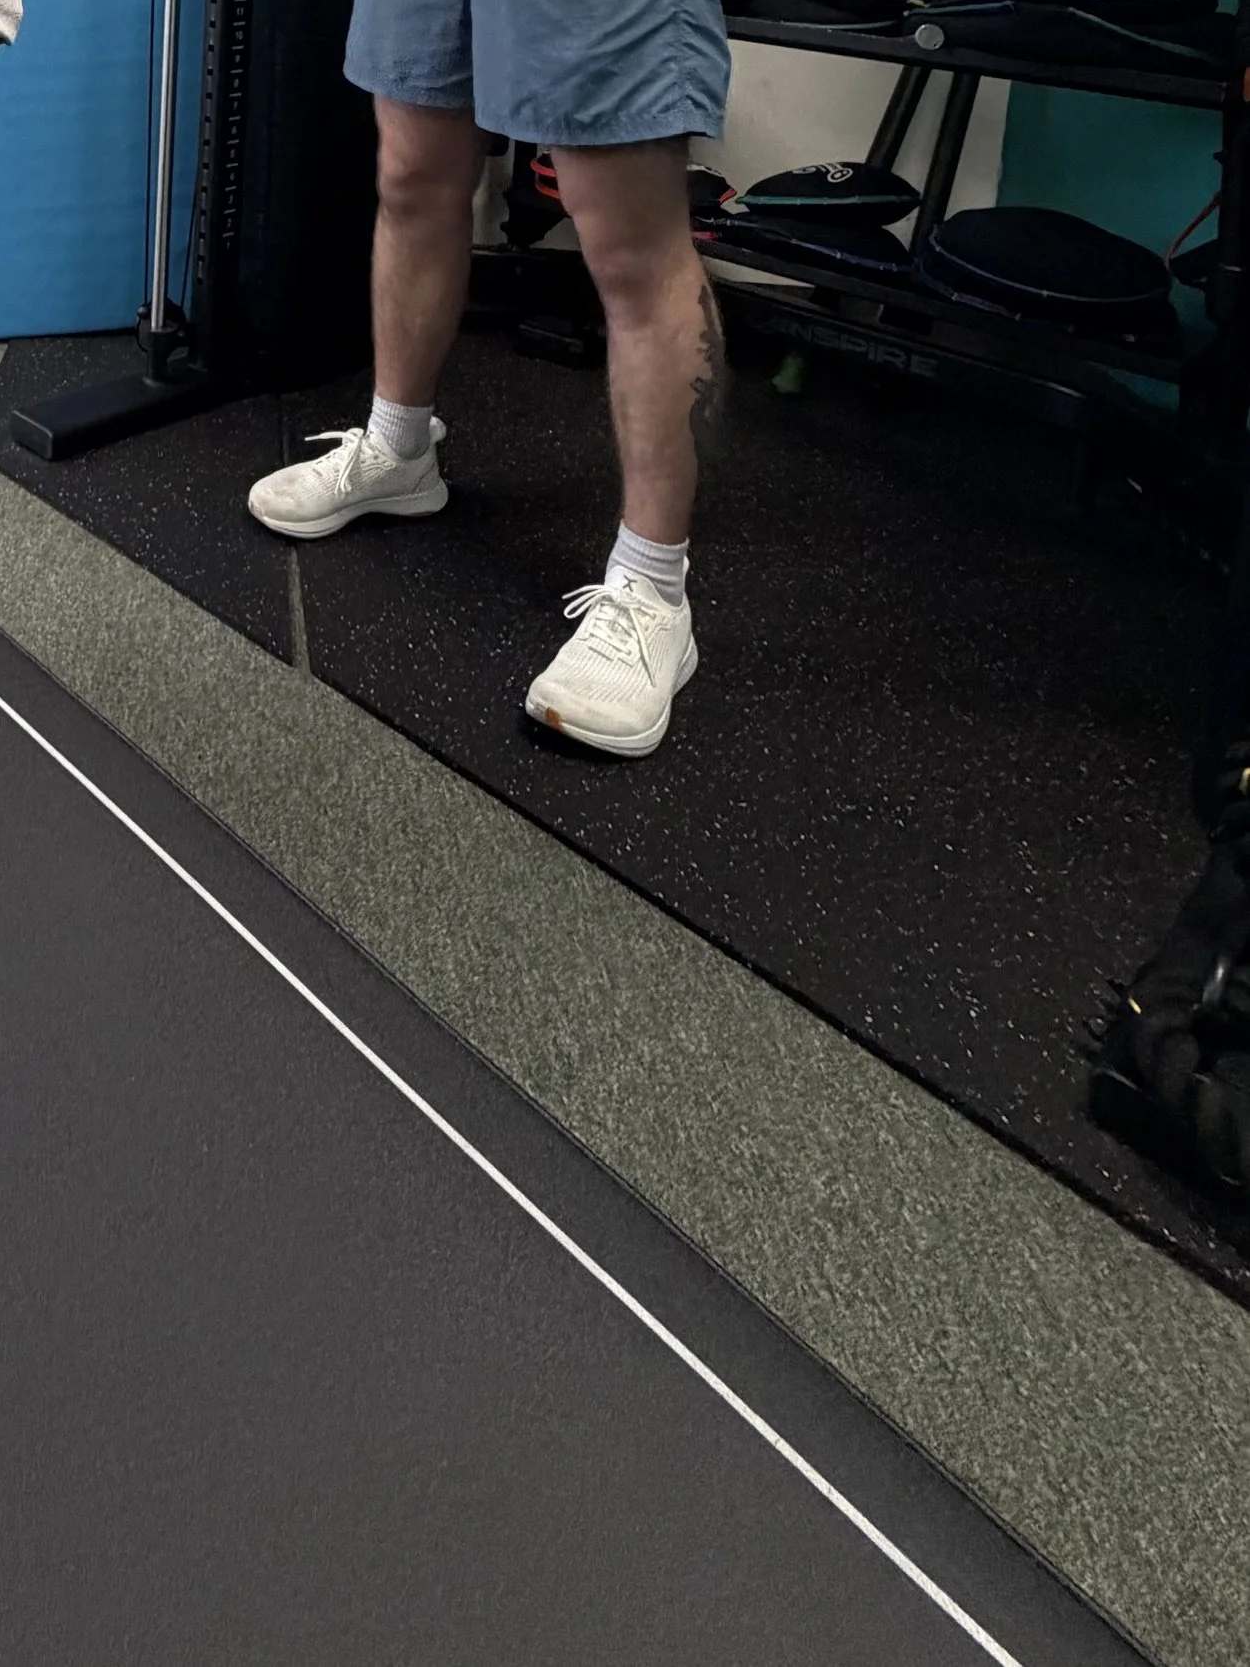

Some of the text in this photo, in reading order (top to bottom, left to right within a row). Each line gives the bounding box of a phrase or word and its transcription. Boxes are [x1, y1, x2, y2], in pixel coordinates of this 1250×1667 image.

[236, 7, 244, 16] 11
[235, 30, 243, 40] 10
[780, 318, 939, 378] INSPIRE
